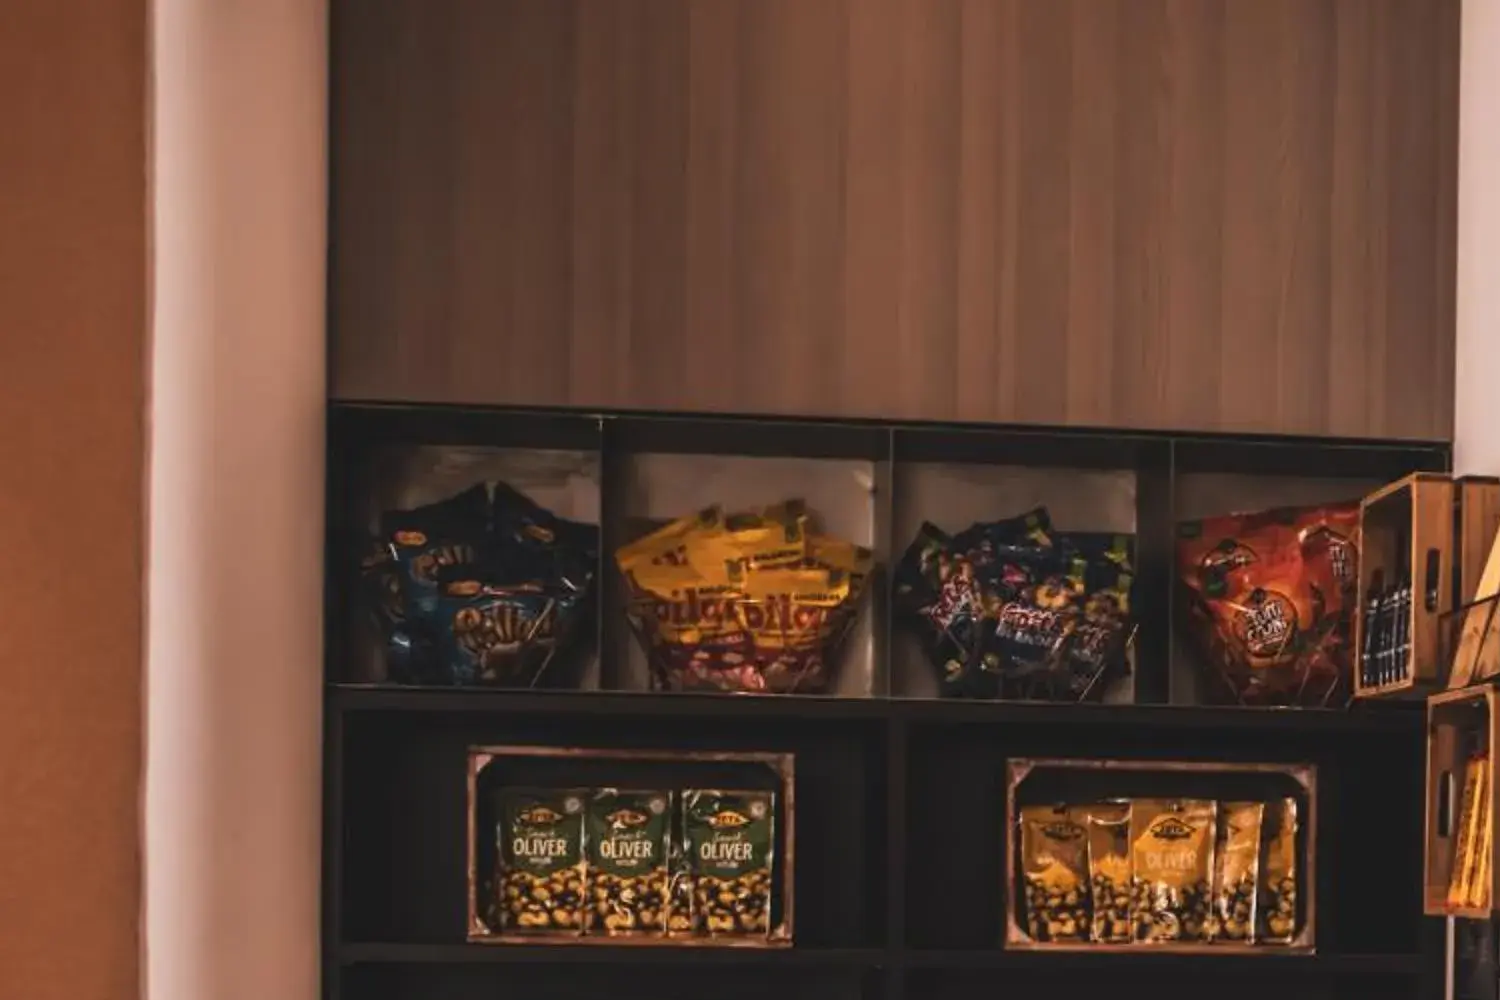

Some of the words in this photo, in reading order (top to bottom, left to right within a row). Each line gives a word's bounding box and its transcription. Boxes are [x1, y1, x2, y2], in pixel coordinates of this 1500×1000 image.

[512, 837, 567, 858] OLIVER
[600, 836, 653, 859] OLIVER
[700, 841, 753, 861] OLIVER
